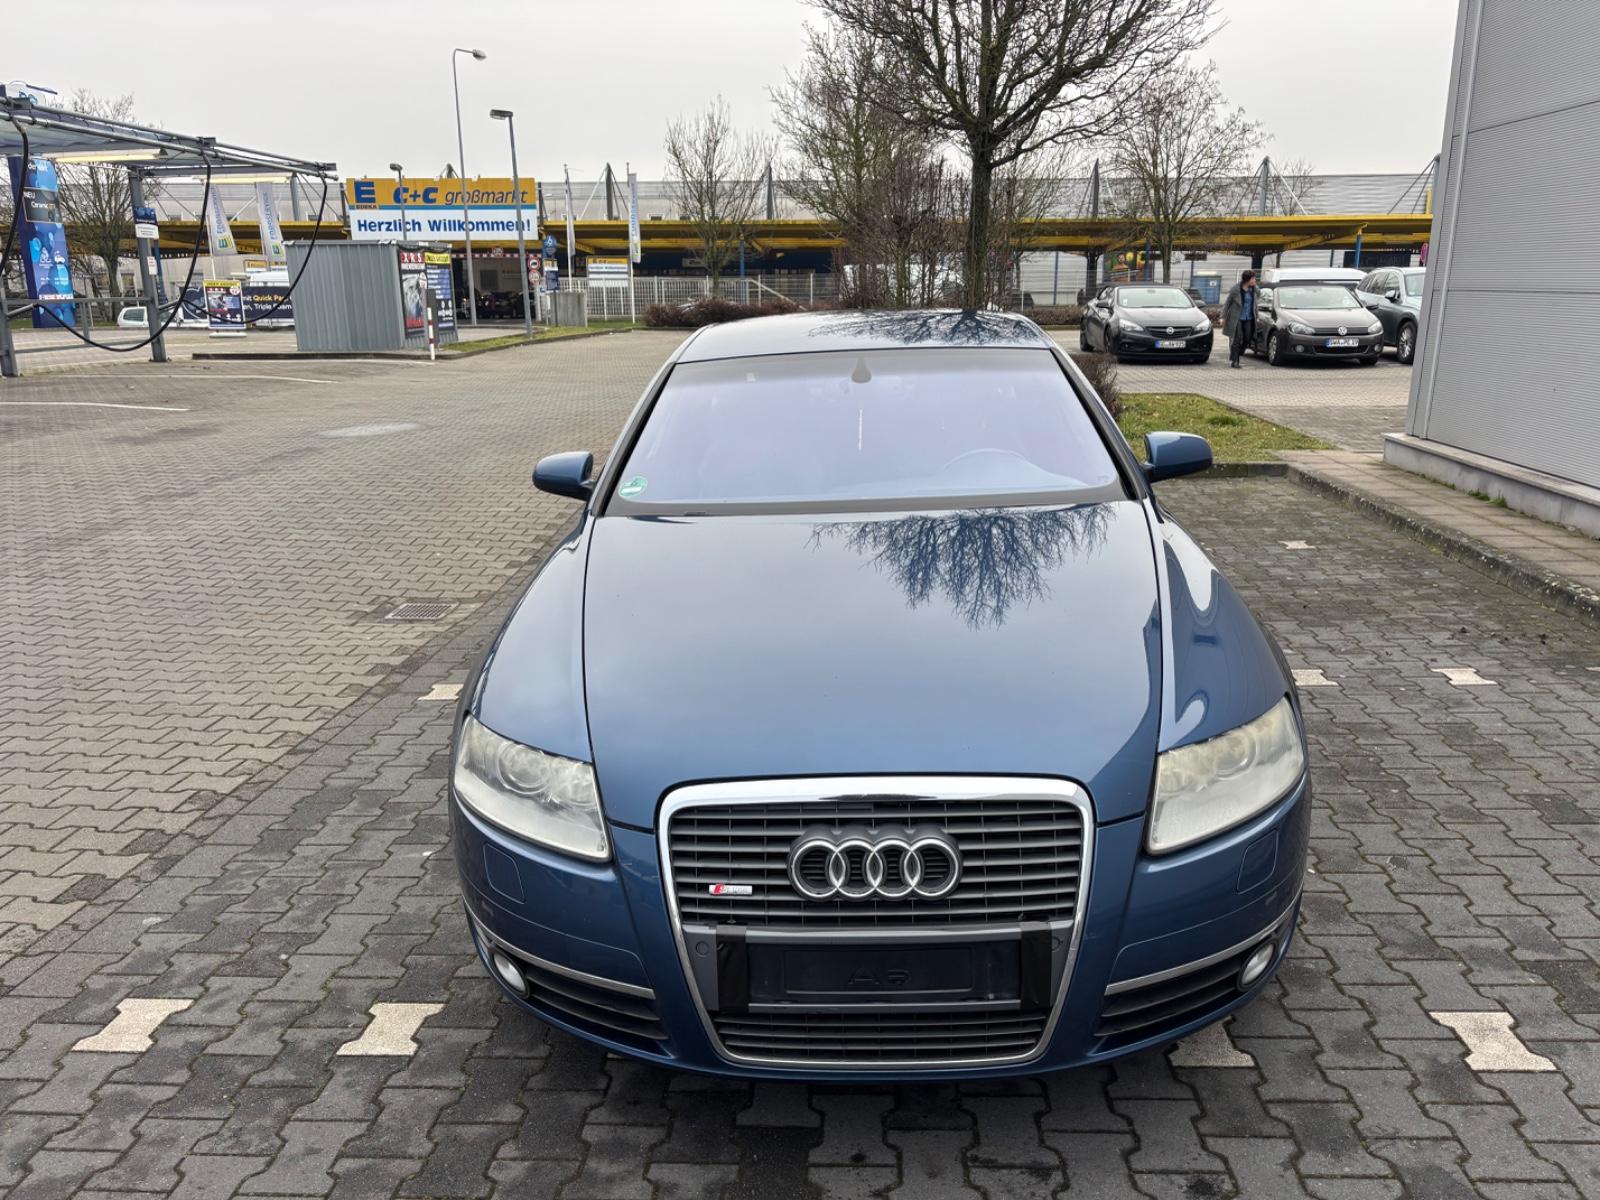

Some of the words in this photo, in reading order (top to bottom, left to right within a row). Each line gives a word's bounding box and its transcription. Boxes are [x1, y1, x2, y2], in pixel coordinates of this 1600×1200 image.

[393, 187, 439, 204] C+C
[356, 219, 422, 232] Herzlich
[427, 219, 531, 232] Willkommen!
[253, 294, 272, 302] Quick
[254, 303, 272, 311] Triple
